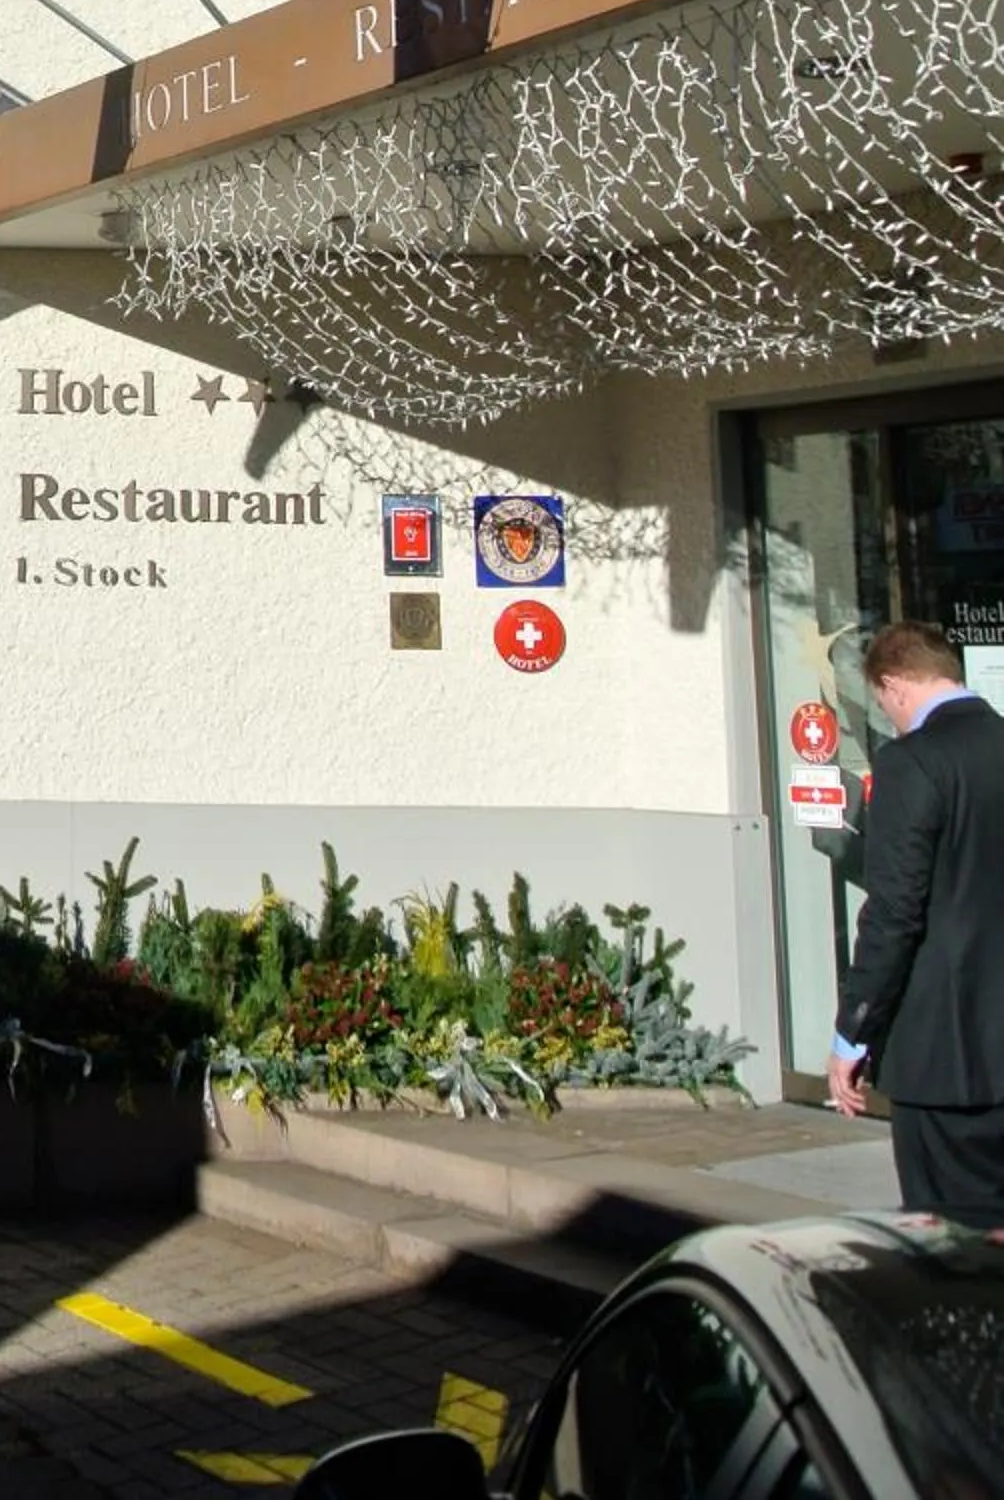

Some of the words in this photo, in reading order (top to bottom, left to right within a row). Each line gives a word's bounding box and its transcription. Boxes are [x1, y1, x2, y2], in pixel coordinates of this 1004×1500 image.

[16, 367, 158, 417] Hotel
[19, 472, 327, 526] Restaurant
[53, 557, 169, 589] Stock
[945, 624, 1004, 644] estaur
[507, 652, 553, 671] HOTEL
